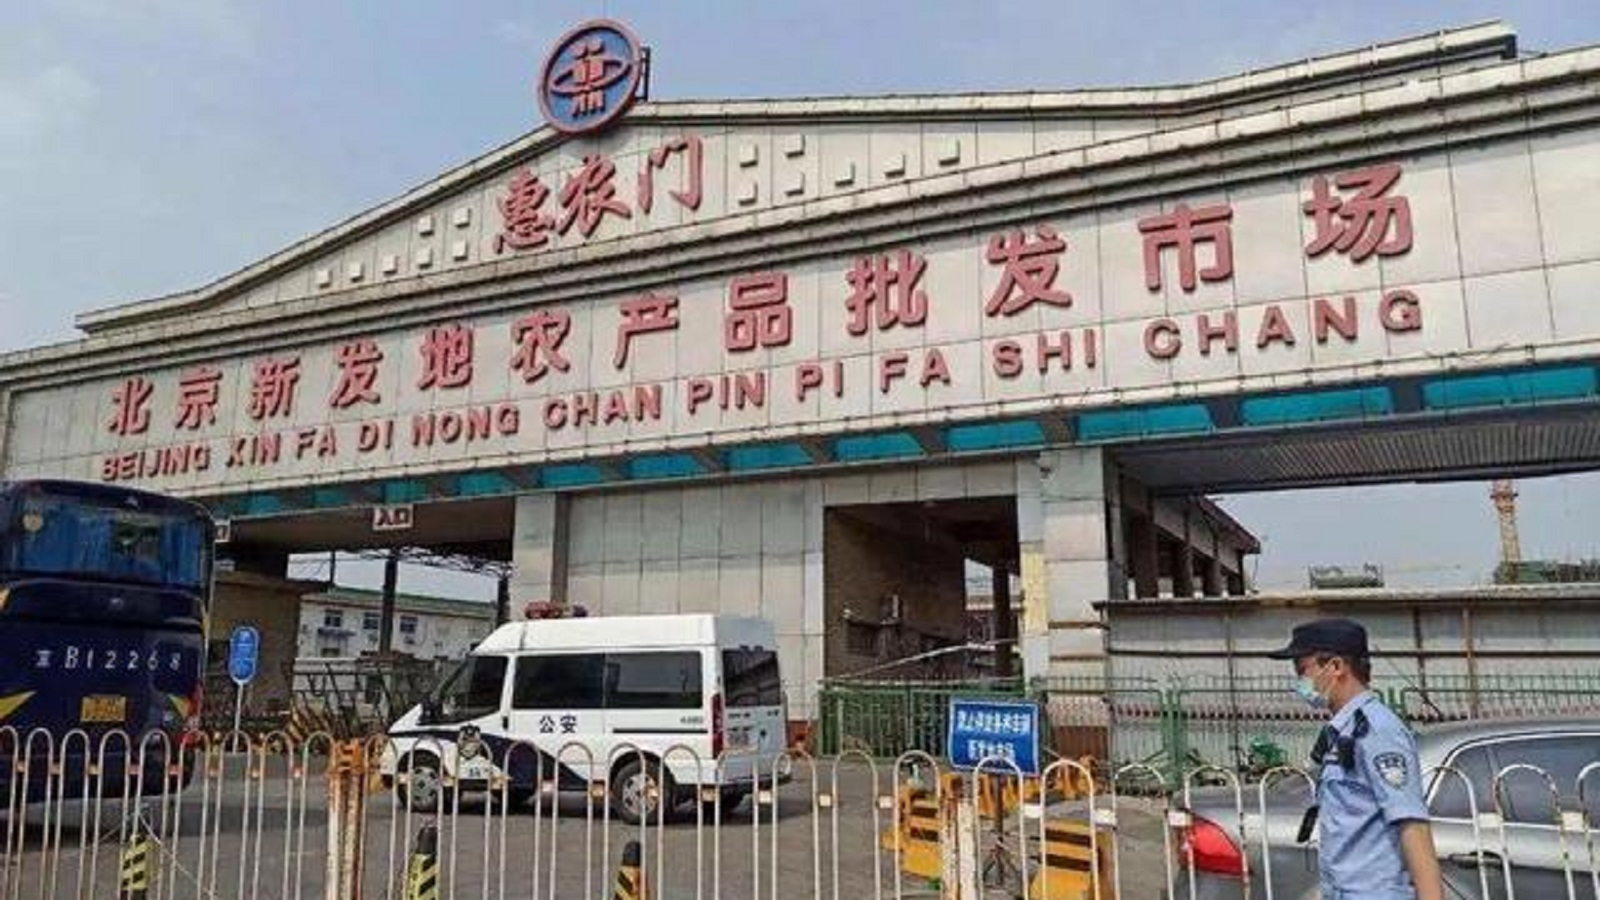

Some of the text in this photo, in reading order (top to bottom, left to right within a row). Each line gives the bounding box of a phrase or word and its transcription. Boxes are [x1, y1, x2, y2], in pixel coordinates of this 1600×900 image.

[494, 135, 702, 254] 惠农门
[108, 164, 1415, 435] 北京新发地农产品批发市场
[102, 288, 1422, 482] BEIJING XIN FA DI NONG CHAN PIN PI FA SHI CHANG
[539, 714, 577, 734] 公安
